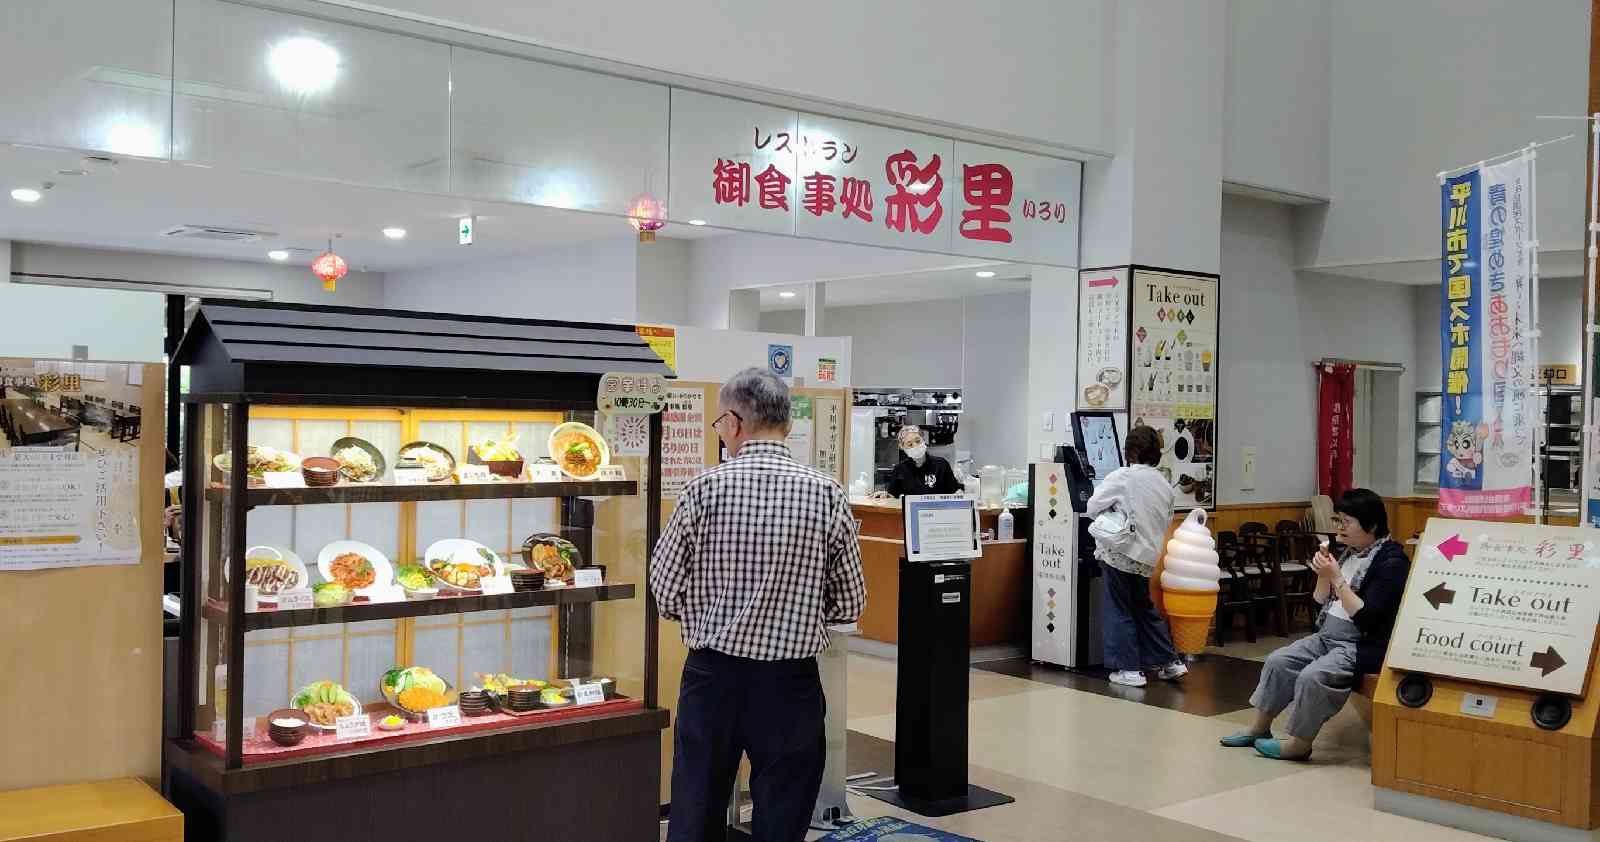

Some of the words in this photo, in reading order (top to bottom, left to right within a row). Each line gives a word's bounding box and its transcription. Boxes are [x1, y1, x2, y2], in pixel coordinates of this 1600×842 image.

[712, 158, 874, 223] 御食事処
[884, 149, 1014, 244] 彩里
[1022, 200, 1066, 223] いろり
[1146, 284, 1180, 304] Take
[1184, 292, 1206, 307] out
[39, 373, 81, 392] 彩里
[1039, 542, 1065, 557] Take
[1042, 558, 1062, 569] out
[1469, 586, 1522, 608] Take
[1531, 595, 1572, 614] out
[1415, 627, 1465, 650] Food
[1469, 636, 1528, 657] court
